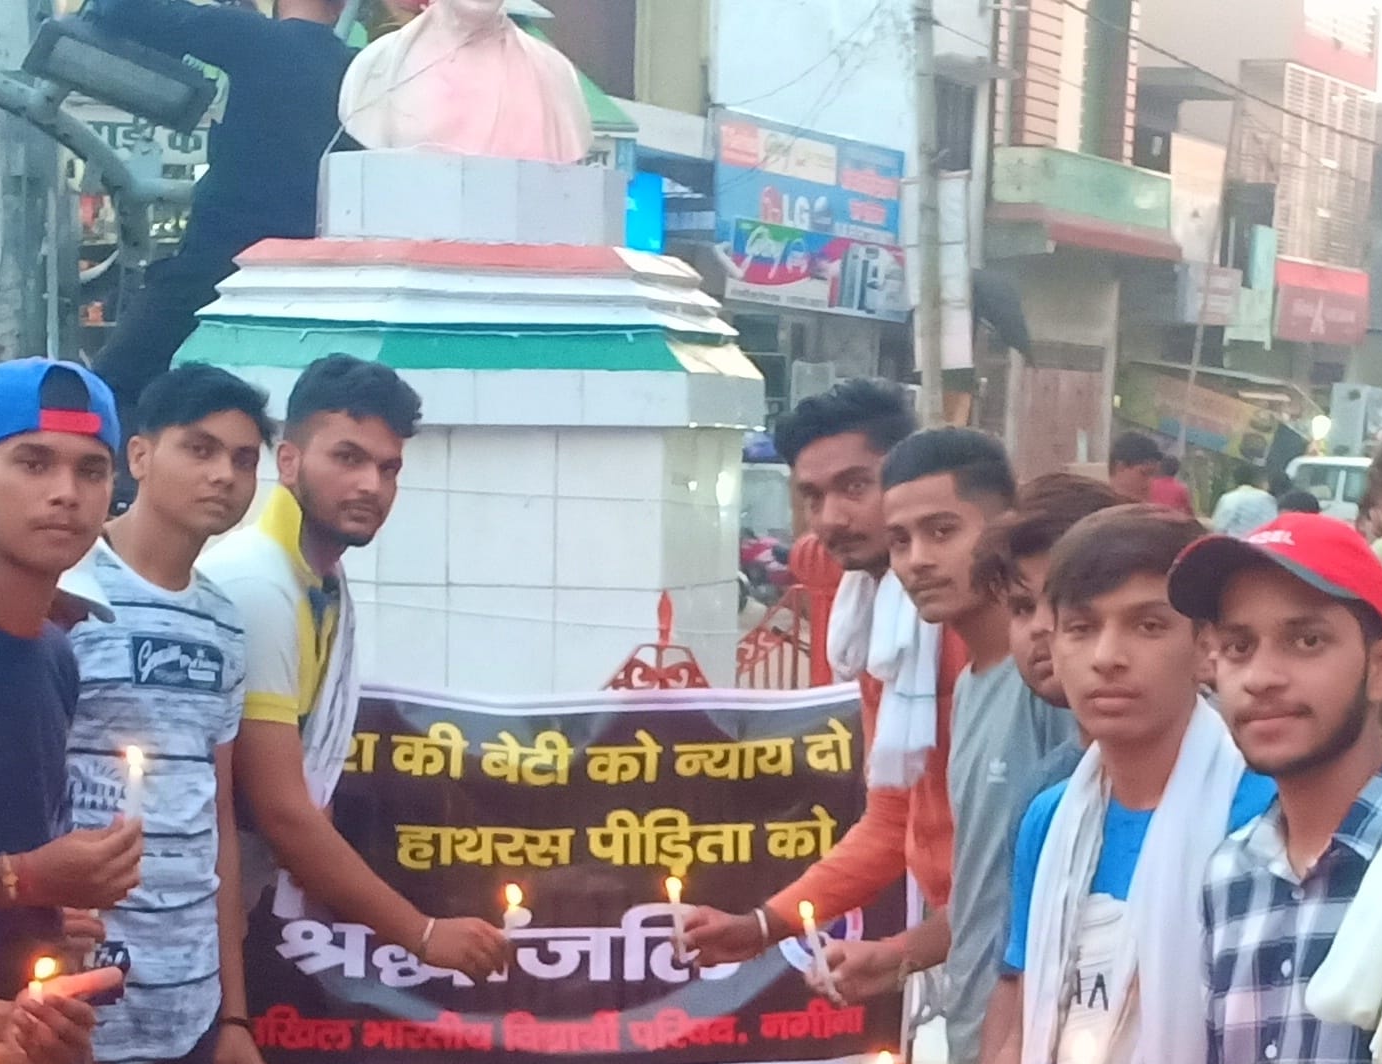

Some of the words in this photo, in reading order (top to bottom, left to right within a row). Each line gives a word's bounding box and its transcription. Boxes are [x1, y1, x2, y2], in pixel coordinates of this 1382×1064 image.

[391, 721, 469, 780] की
[480, 730, 574, 787] बेटी
[585, 729, 663, 785] को
[673, 737, 794, 781] न्याय
[802, 717, 852, 773] दो
[396, 824, 574, 869] हाथरस
[586, 808, 756, 877] पीड़िता
[764, 804, 838, 860] को
